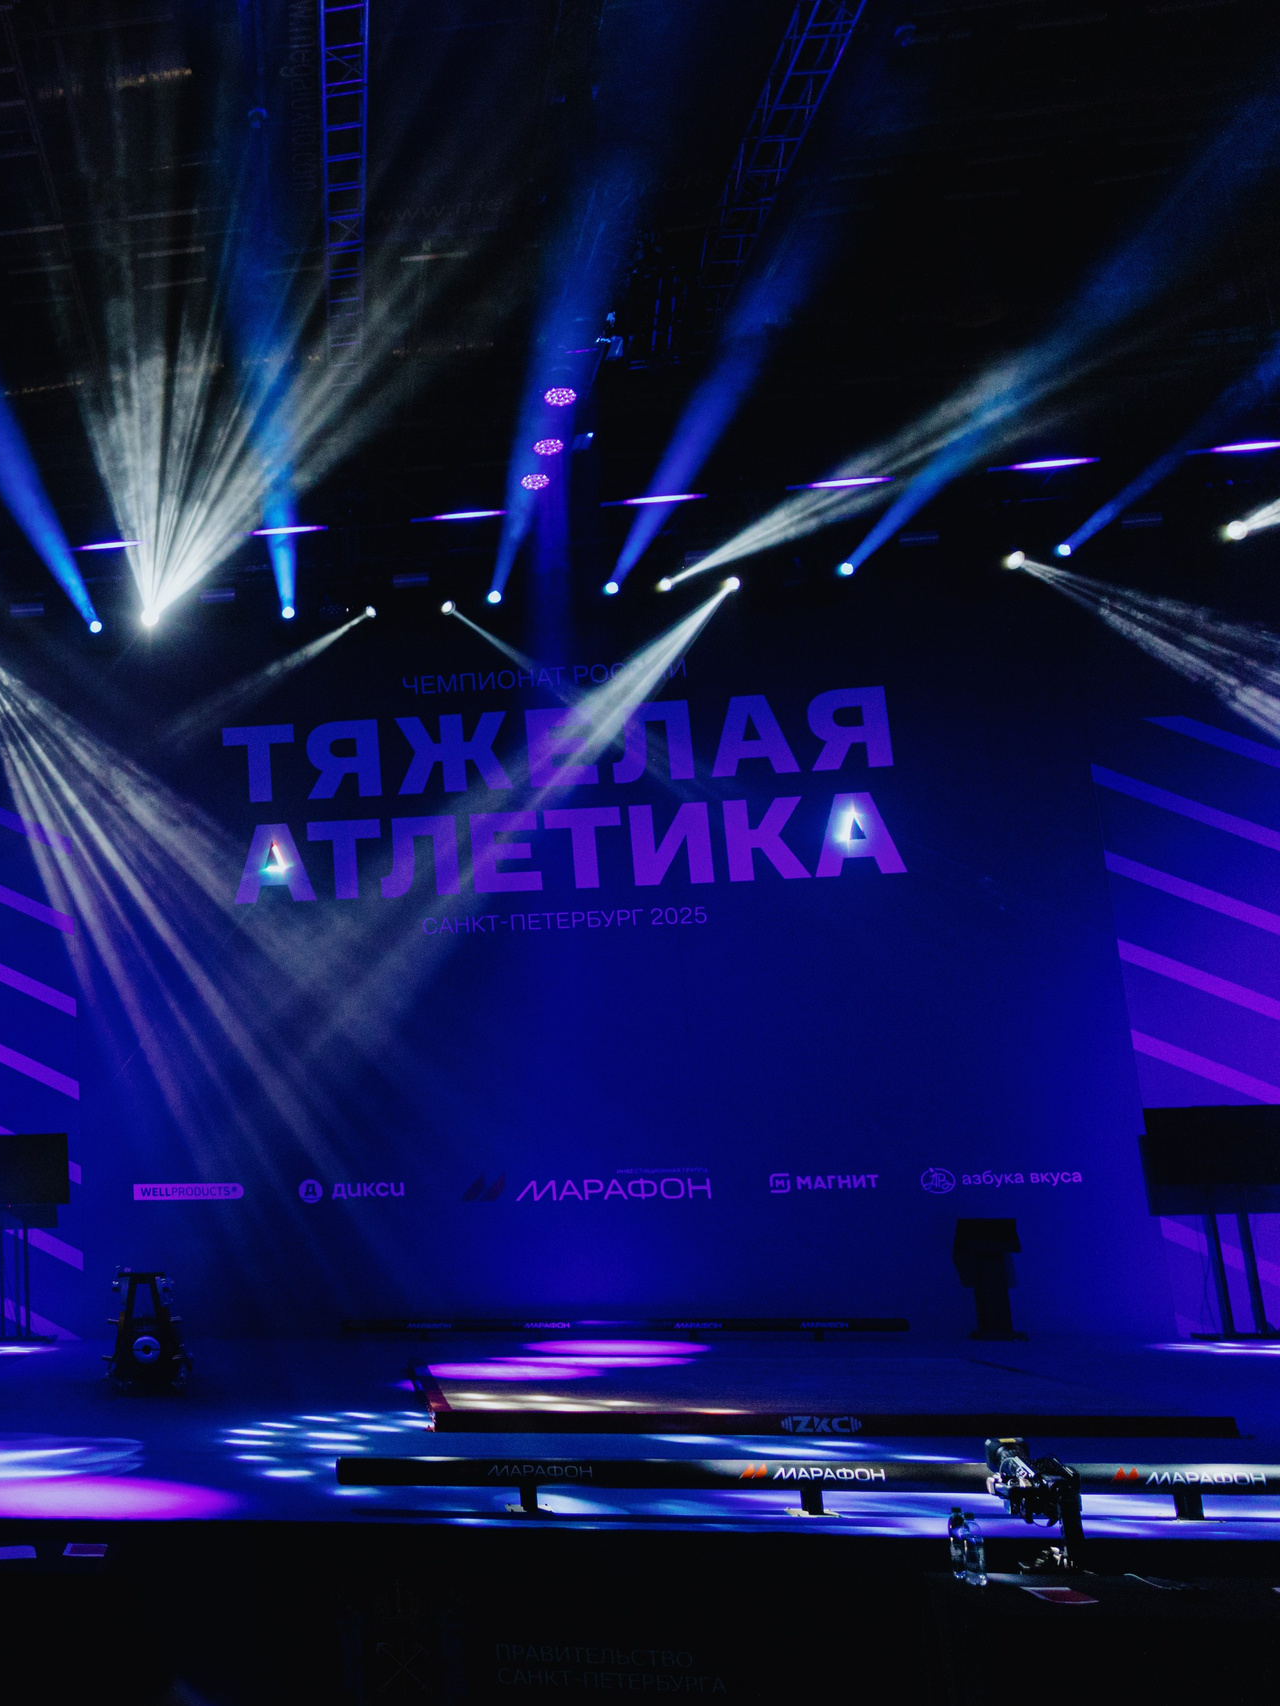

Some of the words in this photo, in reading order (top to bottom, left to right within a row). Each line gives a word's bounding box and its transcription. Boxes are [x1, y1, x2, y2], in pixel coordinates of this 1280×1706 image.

[402, 666, 565, 695] ЧЕМПИОНАТ
[221, 685, 894, 803] ТЯЖЕЛАЯ
[234, 791, 908, 904] АТЛЕТИКА
[422, 908, 644, 935] САНКТ-ПЕТЕРБУРГ
[650, 906, 708, 926] 2025
[516, 1178, 712, 1201] МАРАФОН
[796, 1174, 879, 1190] МАГНИТ
[961, 1170, 1024, 1187] азбука
[1029, 1171, 1082, 1187] вкуса
[523, 1321, 571, 1329] МАРАФОН
[487, 1465, 593, 1479] МАРАФОН
[772, 1467, 886, 1482] МАРАФОН
[1145, 1470, 1267, 1486] МАРАФОН
[495, 1643, 694, 1667] ПРАВИТЕЛЬСТВО
[497, 1667, 727, 1694] САНКТ-ПЕТЕРБУРГА
